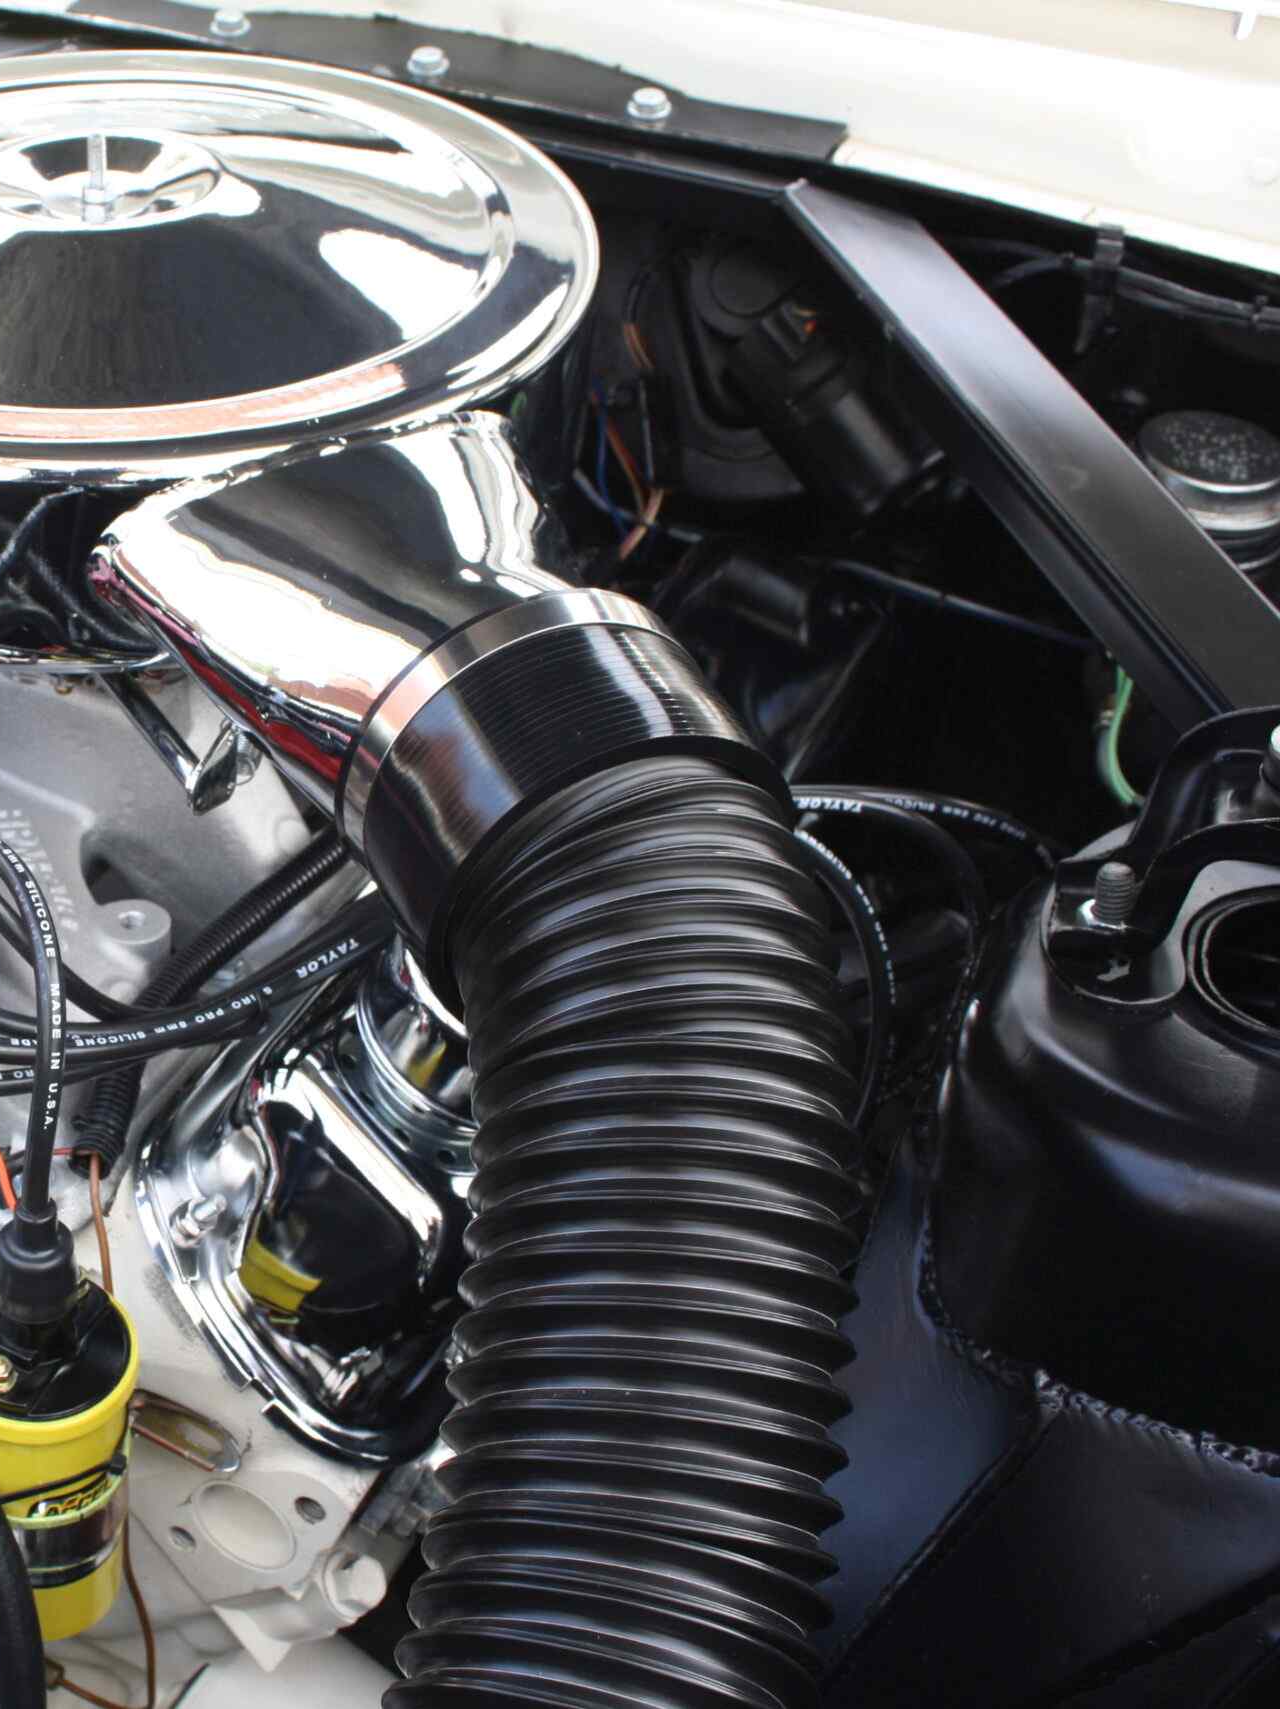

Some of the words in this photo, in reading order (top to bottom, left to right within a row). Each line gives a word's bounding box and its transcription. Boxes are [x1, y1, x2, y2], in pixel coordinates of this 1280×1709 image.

[797, 797, 863, 813] TAYLOR
[24, 880, 56, 958] SILICONE
[296, 938, 360, 979] TAYLOR
[49, 983, 61, 1039] MADE
[195, 1008, 224, 1023] PRO
[155, 1020, 188, 1034] 8mm
[76, 1031, 147, 1047] SILICONE
[50, 1052, 60, 1070] IN
[43, 1082, 59, 1129] U.S.A.
